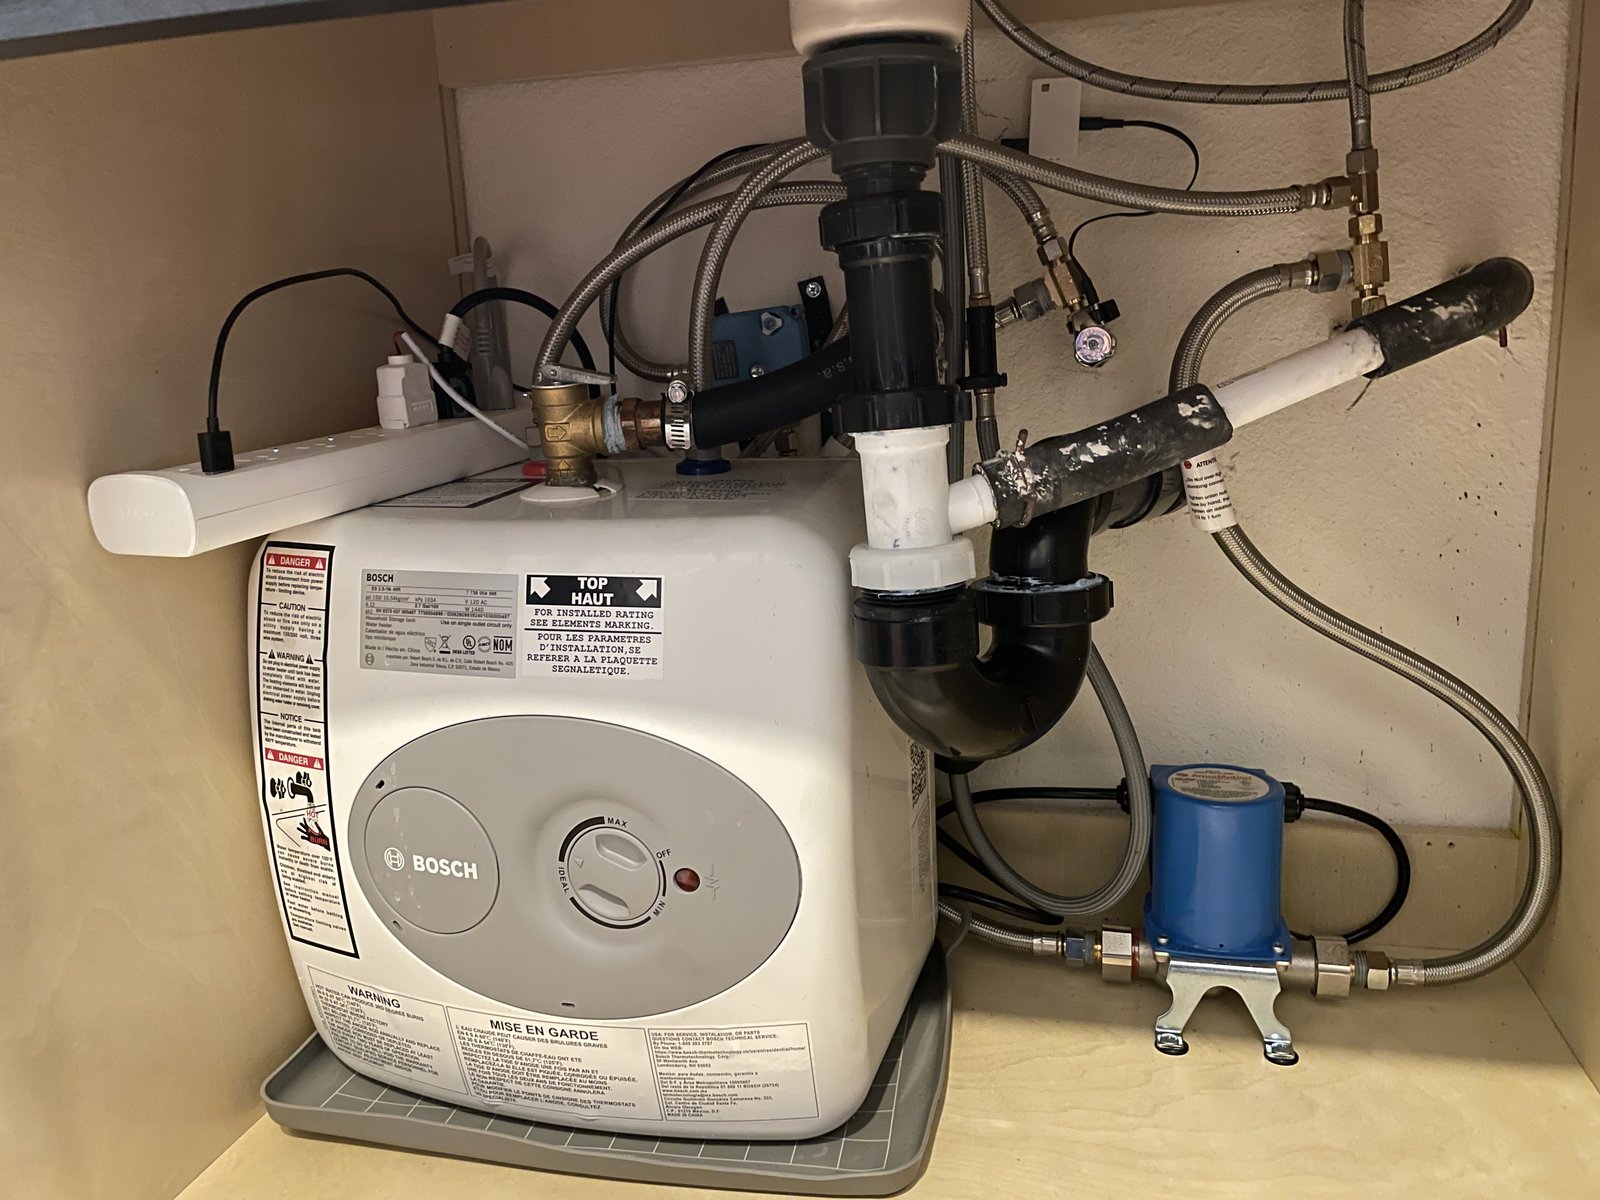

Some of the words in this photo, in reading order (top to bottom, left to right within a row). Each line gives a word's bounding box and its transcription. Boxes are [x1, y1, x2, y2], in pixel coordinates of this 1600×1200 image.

[280, 556, 310, 567] DANGER
[366, 574, 394, 582] BOSCH
[578, 577, 608, 590] TOP
[571, 592, 614, 606] HAUT
[279, 602, 306, 611] CAUTION
[557, 609, 612, 618] INSTALLED
[616, 610, 654, 619] RATING
[552, 620, 601, 628] ELEMENTS
[604, 621, 654, 630] MARKING.
[493, 639, 512, 651] NOM
[588, 635, 651, 644] PARAMETRES
[276, 651, 304, 662] WARNING
[527, 654, 570, 662] REFERER
[601, 656, 658, 665] PLAQUETTE
[552, 665, 630, 676] SEGNALETIQUE.
[281, 713, 302, 722] NOTICE
[278, 753, 308, 766] DANGER
[306, 810, 318, 818] HOT
[608, 817, 628, 828] MAX
[656, 849, 672, 858] OFF
[413, 854, 478, 879] BOSCH
[558, 866, 570, 894] IDEAL
[653, 900, 666, 916] MIN
[347, 985, 401, 1008] WARNING
[490, 1020, 522, 1033] MISE
[526, 1024, 544, 1036] EN
[548, 1027, 600, 1040] GARDE
[473, 1027, 494, 1036] CHAUDE
[512, 1033, 535, 1042] CAUSER
[550, 1038, 581, 1047] BRULURES
